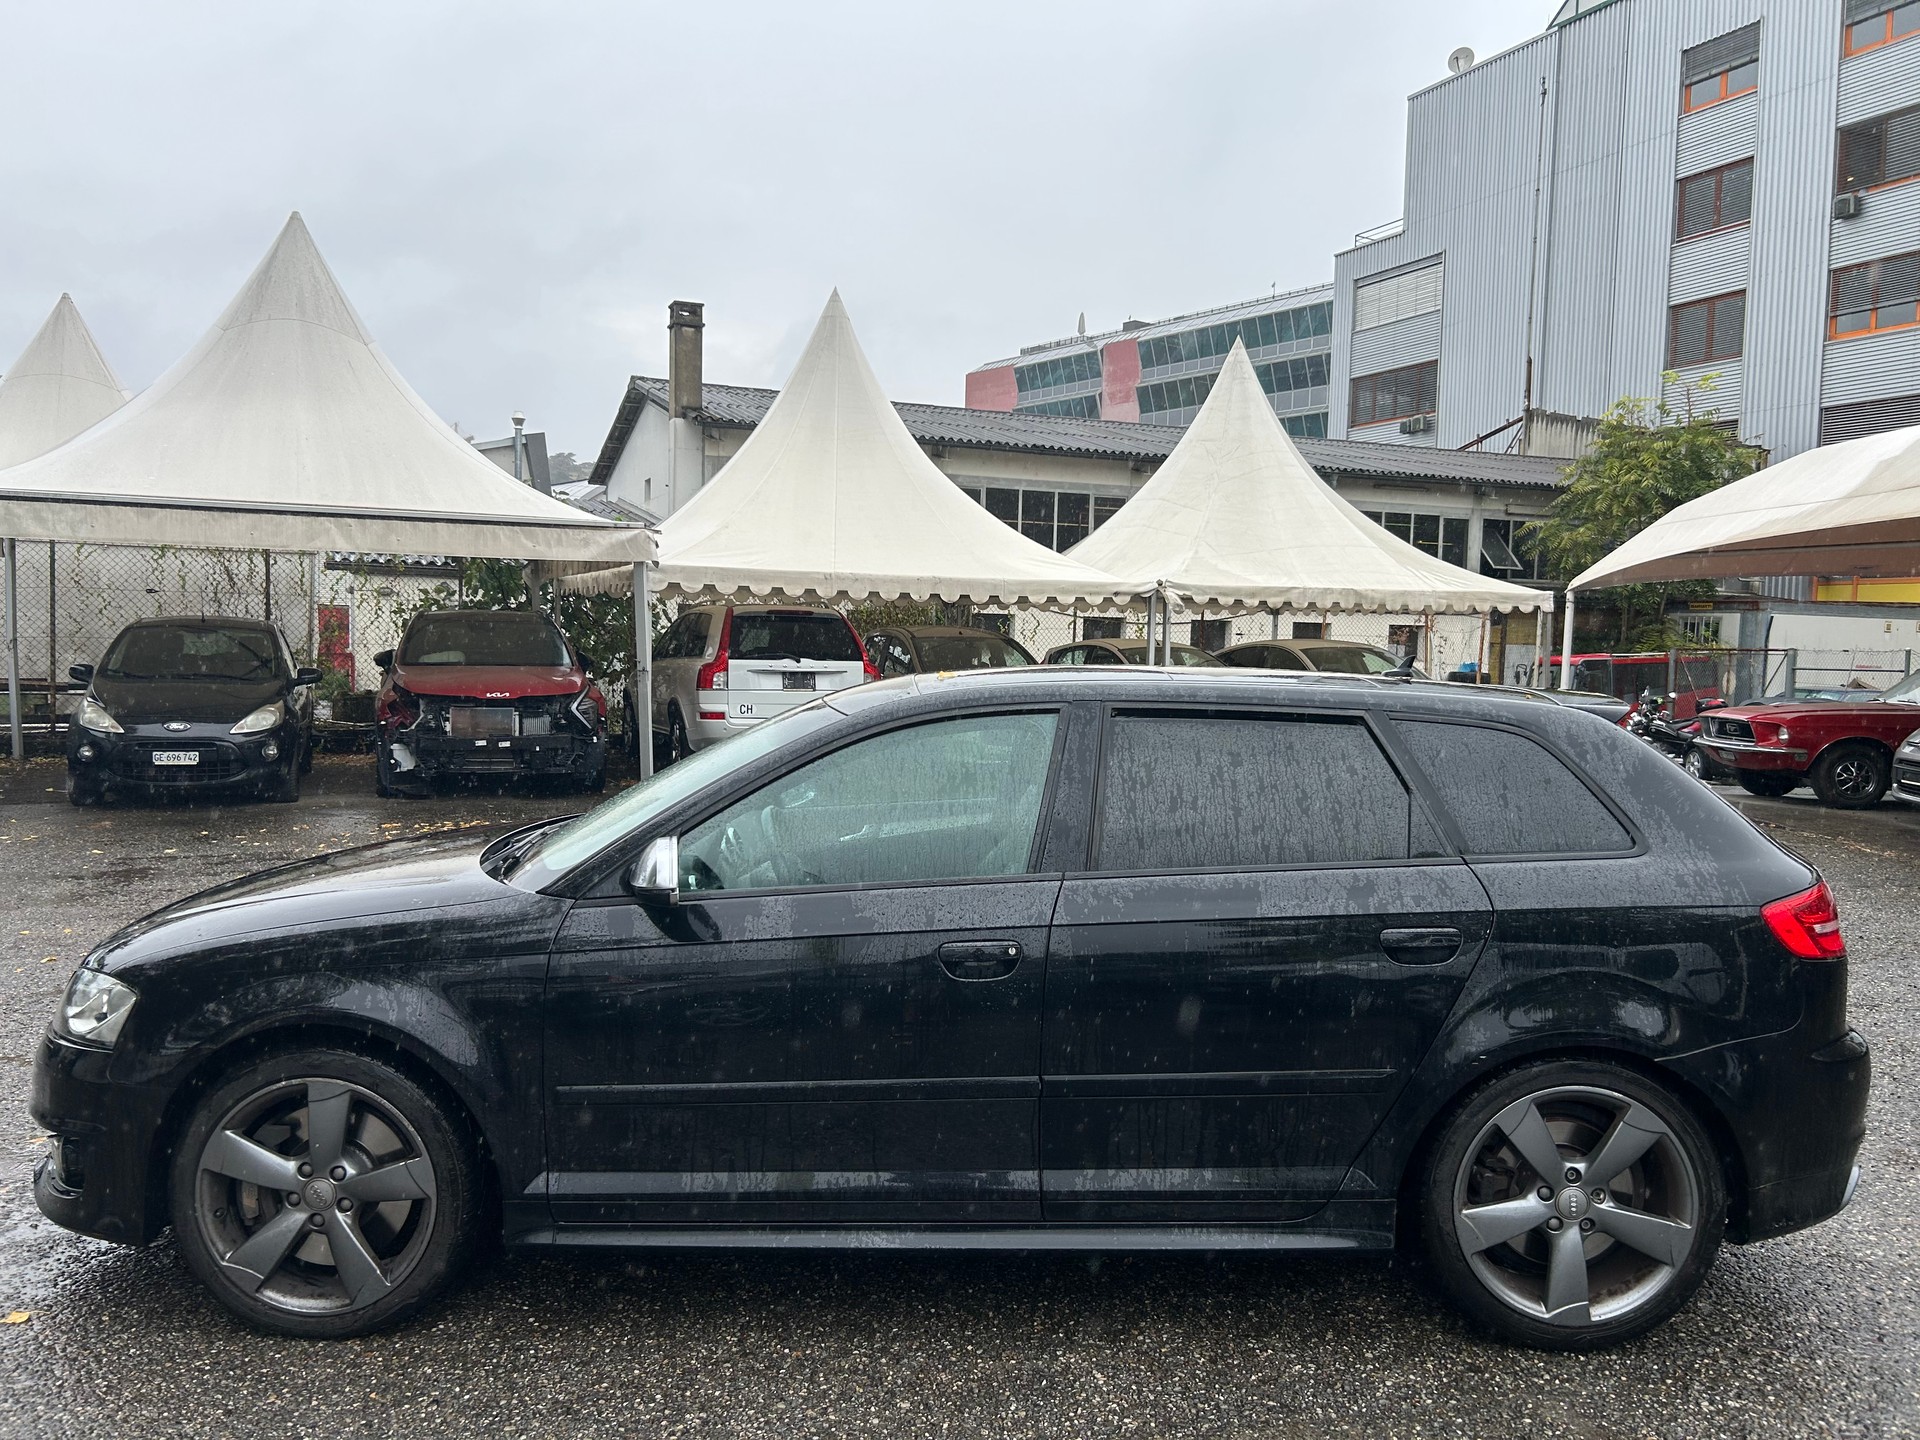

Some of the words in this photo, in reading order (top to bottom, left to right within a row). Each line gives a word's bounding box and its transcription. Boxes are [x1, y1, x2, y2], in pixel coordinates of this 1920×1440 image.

[740, 704, 753, 714] CH
[154, 753, 164, 761] GE
[166, 753, 181, 761] 696
[183, 753, 197, 761] 742
